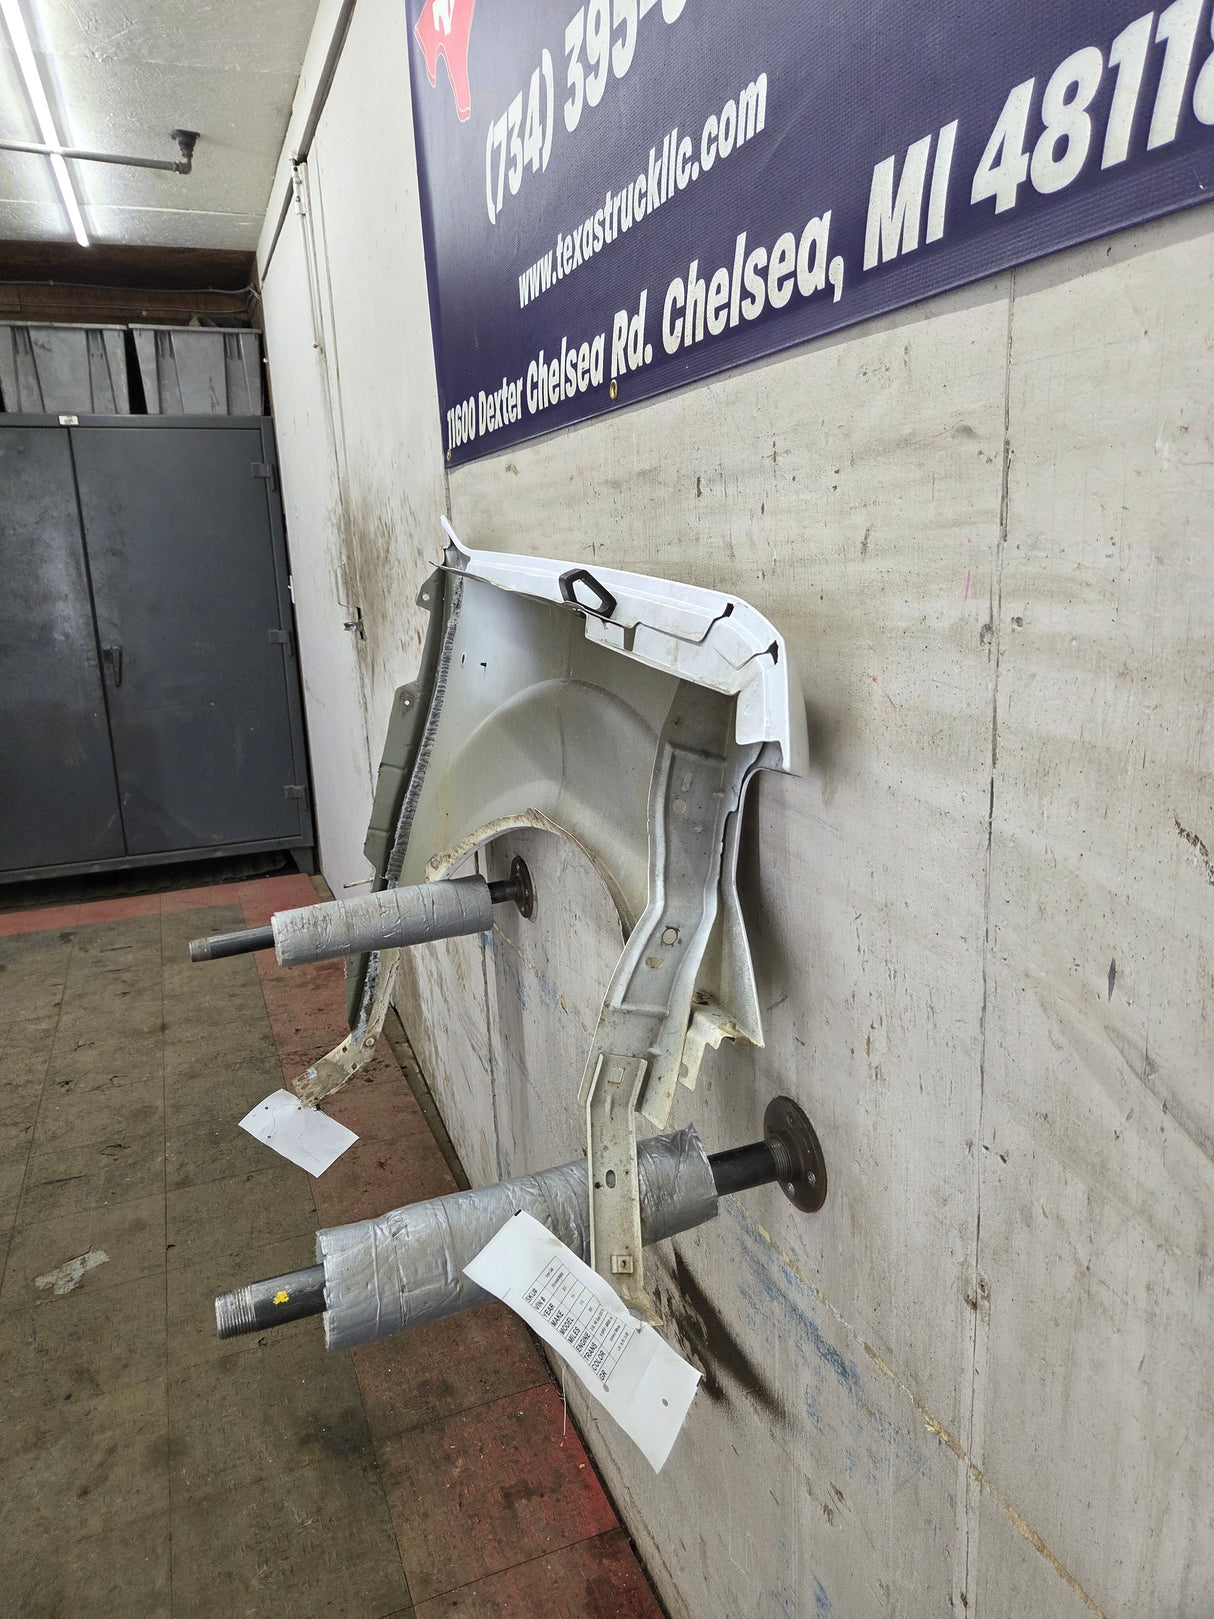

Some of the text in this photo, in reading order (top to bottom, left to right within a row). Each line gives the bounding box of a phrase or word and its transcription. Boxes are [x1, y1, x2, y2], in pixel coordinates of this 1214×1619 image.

[486, 0, 687, 223] (734) 395-
[518, 72, 768, 309] www.texastruckllc.com
[447, 0, 1214, 449] 11600 Dexter Chelsea Rd. Chelsea, MI 4811
[525, 1287, 538, 1303] SKU#
[534, 1300, 544, 1311] VIN
[543, 1302, 556, 1318] YEAR
[550, 1310, 564, 1327] MAKE
[559, 1316, 574, 1335] MODEL
[568, 1326, 581, 1344] MILES
[575, 1331, 591, 1353] ENGINE
[583, 1342, 598, 1361] TRANS
[591, 1350, 606, 1371] COLOR
[599, 1369, 608, 1381] GR
